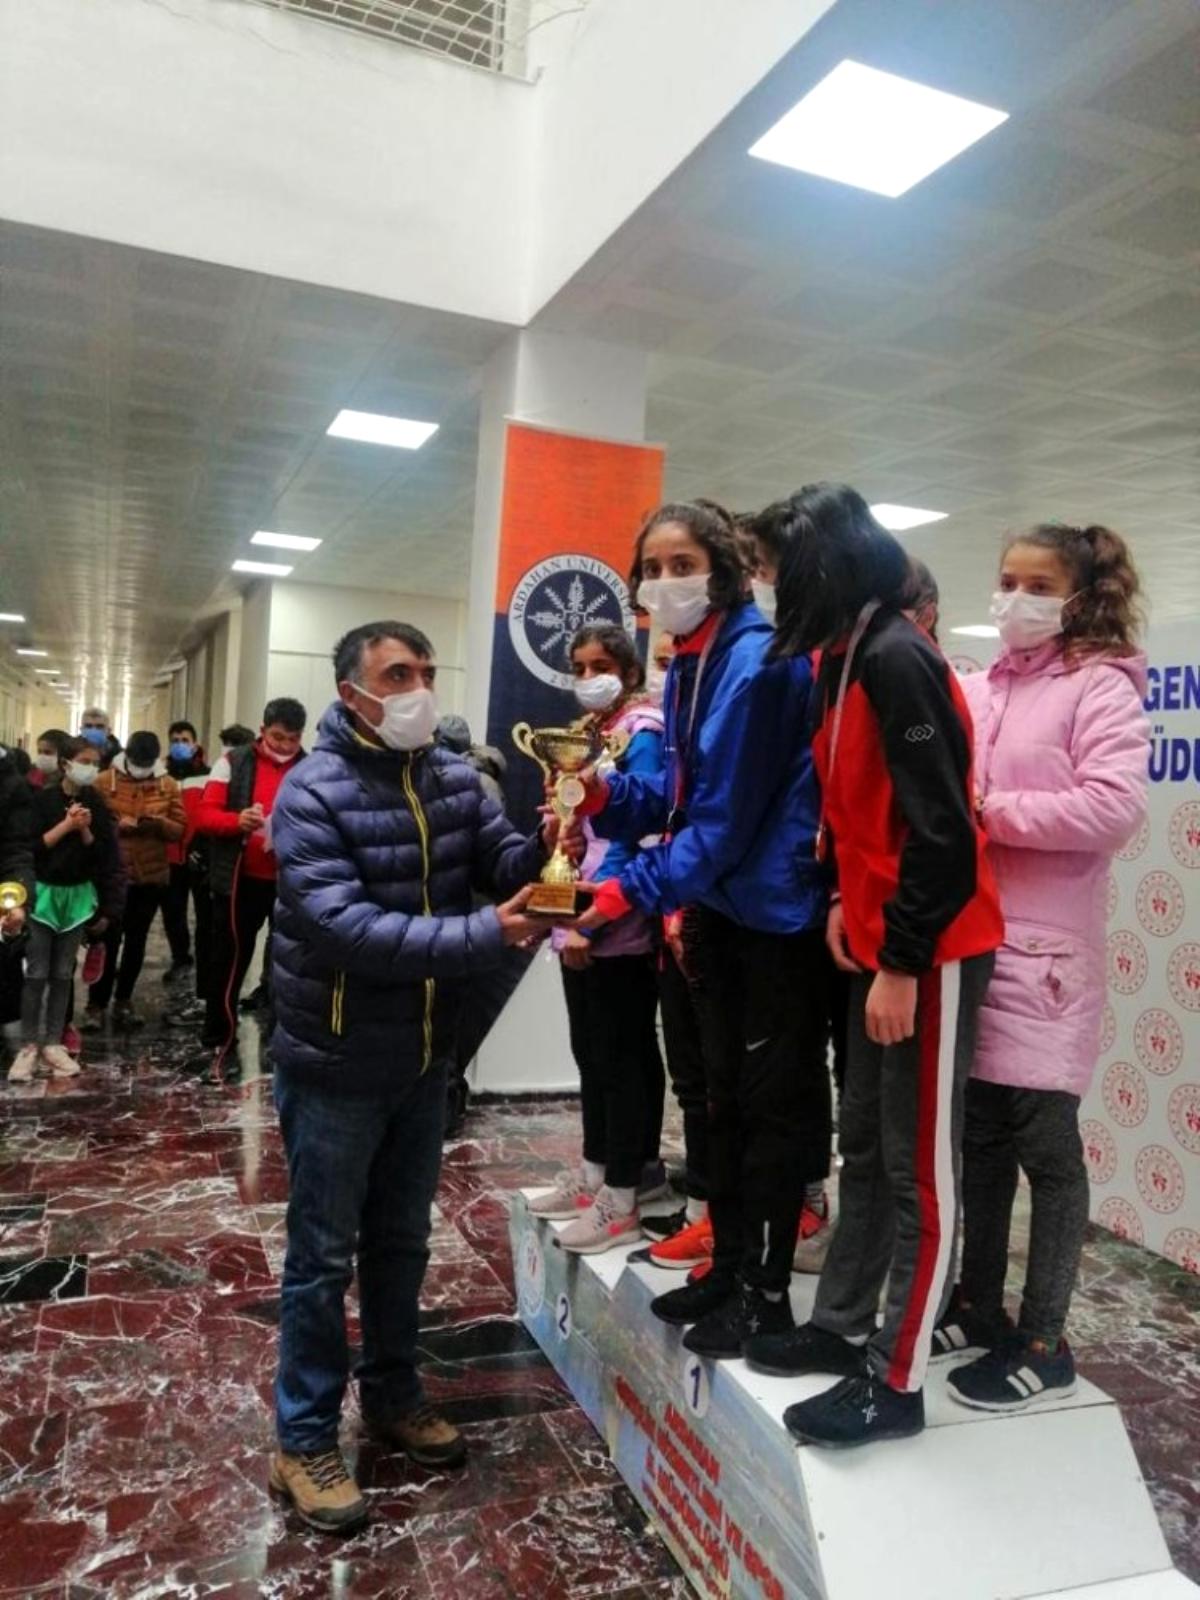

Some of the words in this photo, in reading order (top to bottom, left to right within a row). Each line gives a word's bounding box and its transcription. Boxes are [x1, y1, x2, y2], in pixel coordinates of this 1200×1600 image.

[512, 560, 562, 624] ARDAHAN
[559, 1297, 569, 1335] 2
[690, 1365, 701, 1409] 1
